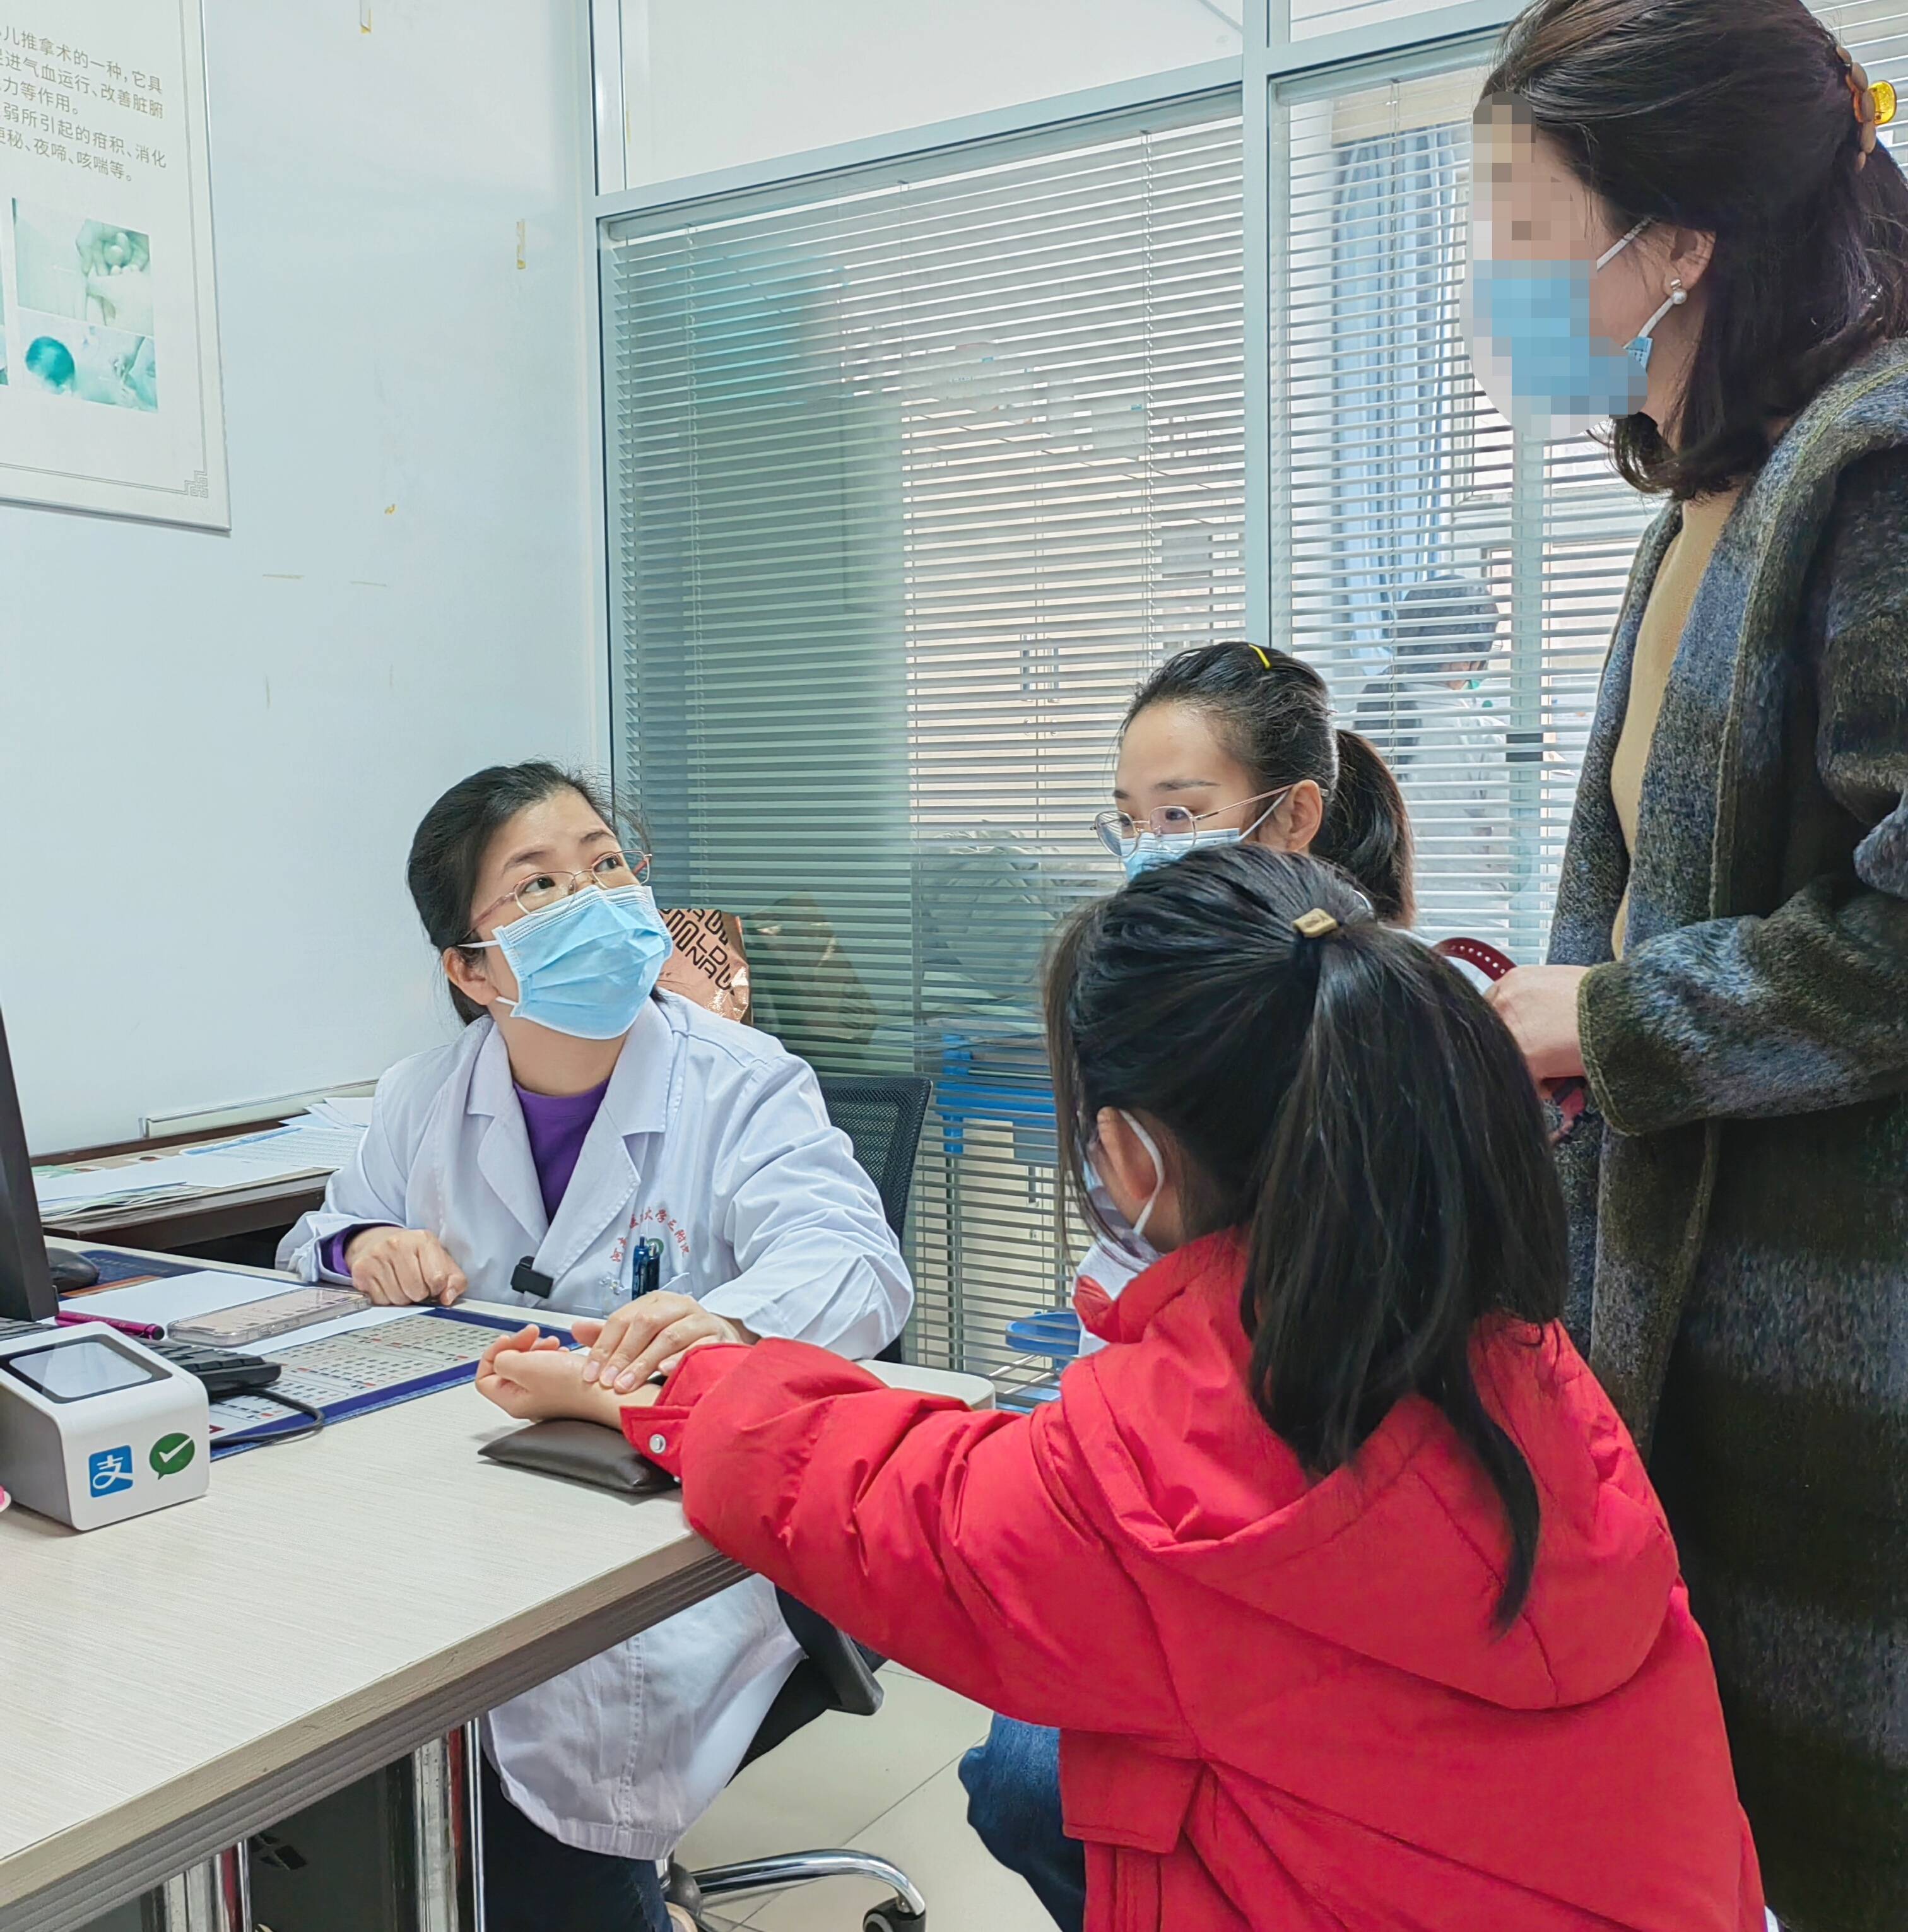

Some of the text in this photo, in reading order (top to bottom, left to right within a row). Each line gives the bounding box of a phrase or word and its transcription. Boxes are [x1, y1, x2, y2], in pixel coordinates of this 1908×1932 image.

[0, 25, 162, 94] 儿推拿术的一种，它具
[0, 49, 163, 119] 进气血运行、改善脏腑
